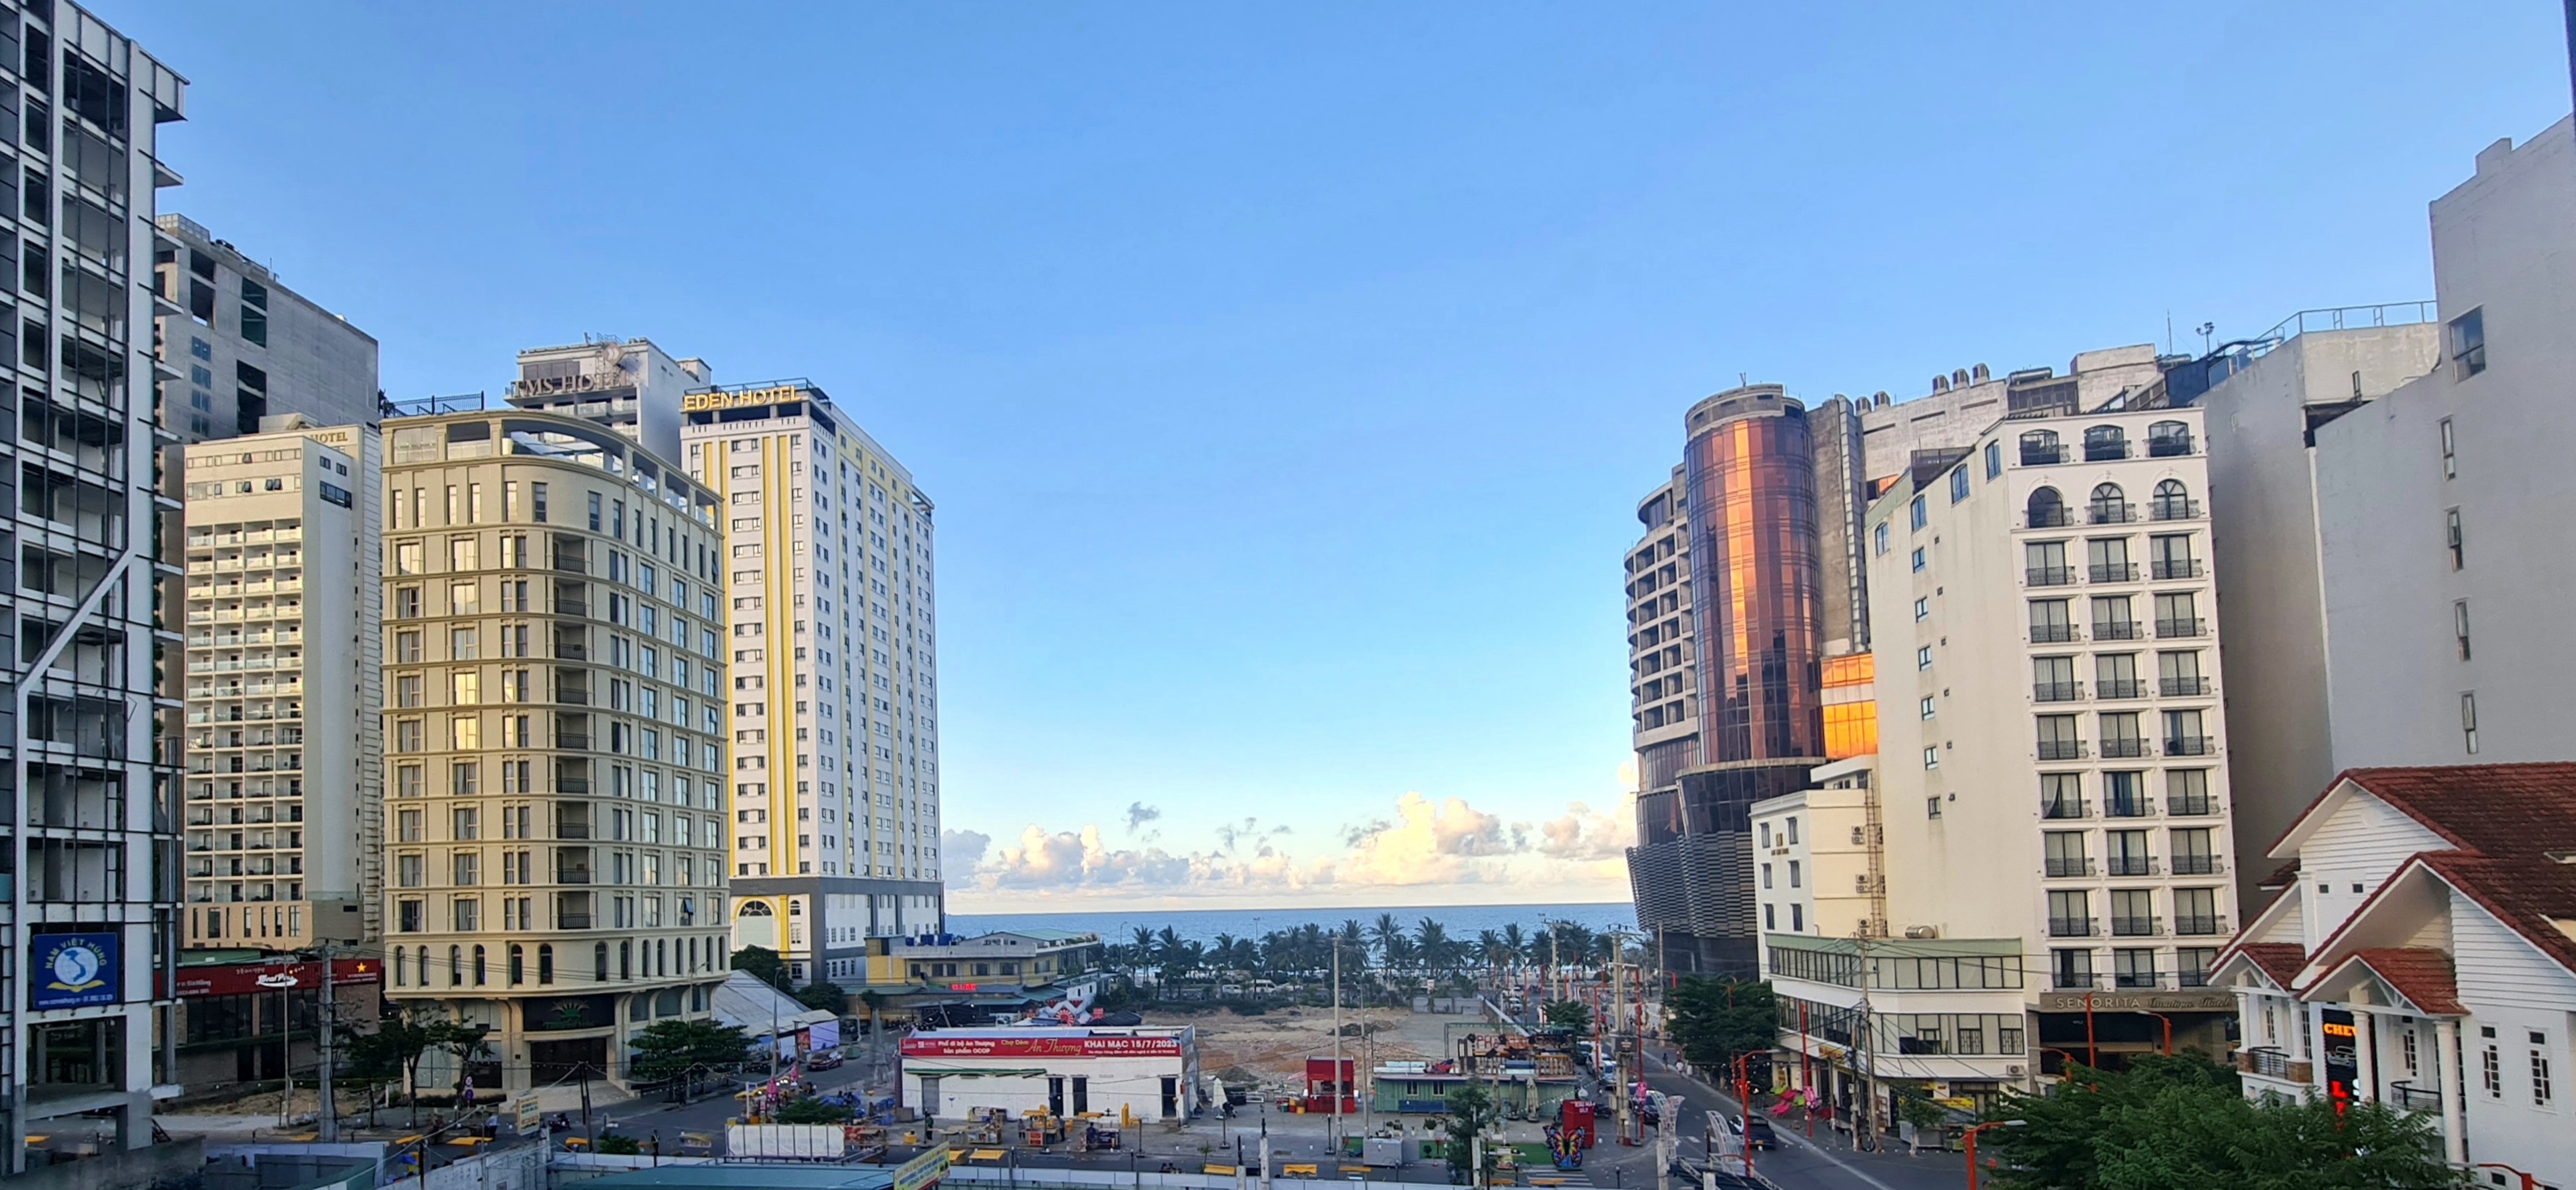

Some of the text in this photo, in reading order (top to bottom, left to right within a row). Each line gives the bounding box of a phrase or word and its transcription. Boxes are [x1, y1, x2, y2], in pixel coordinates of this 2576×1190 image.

[512, 370, 633, 397] TMS HOTEL
[684, 385, 801, 411] EDEN HOTEL
[45, 947, 60, 969] NAM
[1025, 1038, 1042, 1053] An
[1084, 1040, 1177, 1050] KHAI MẠC 15/7/2023
